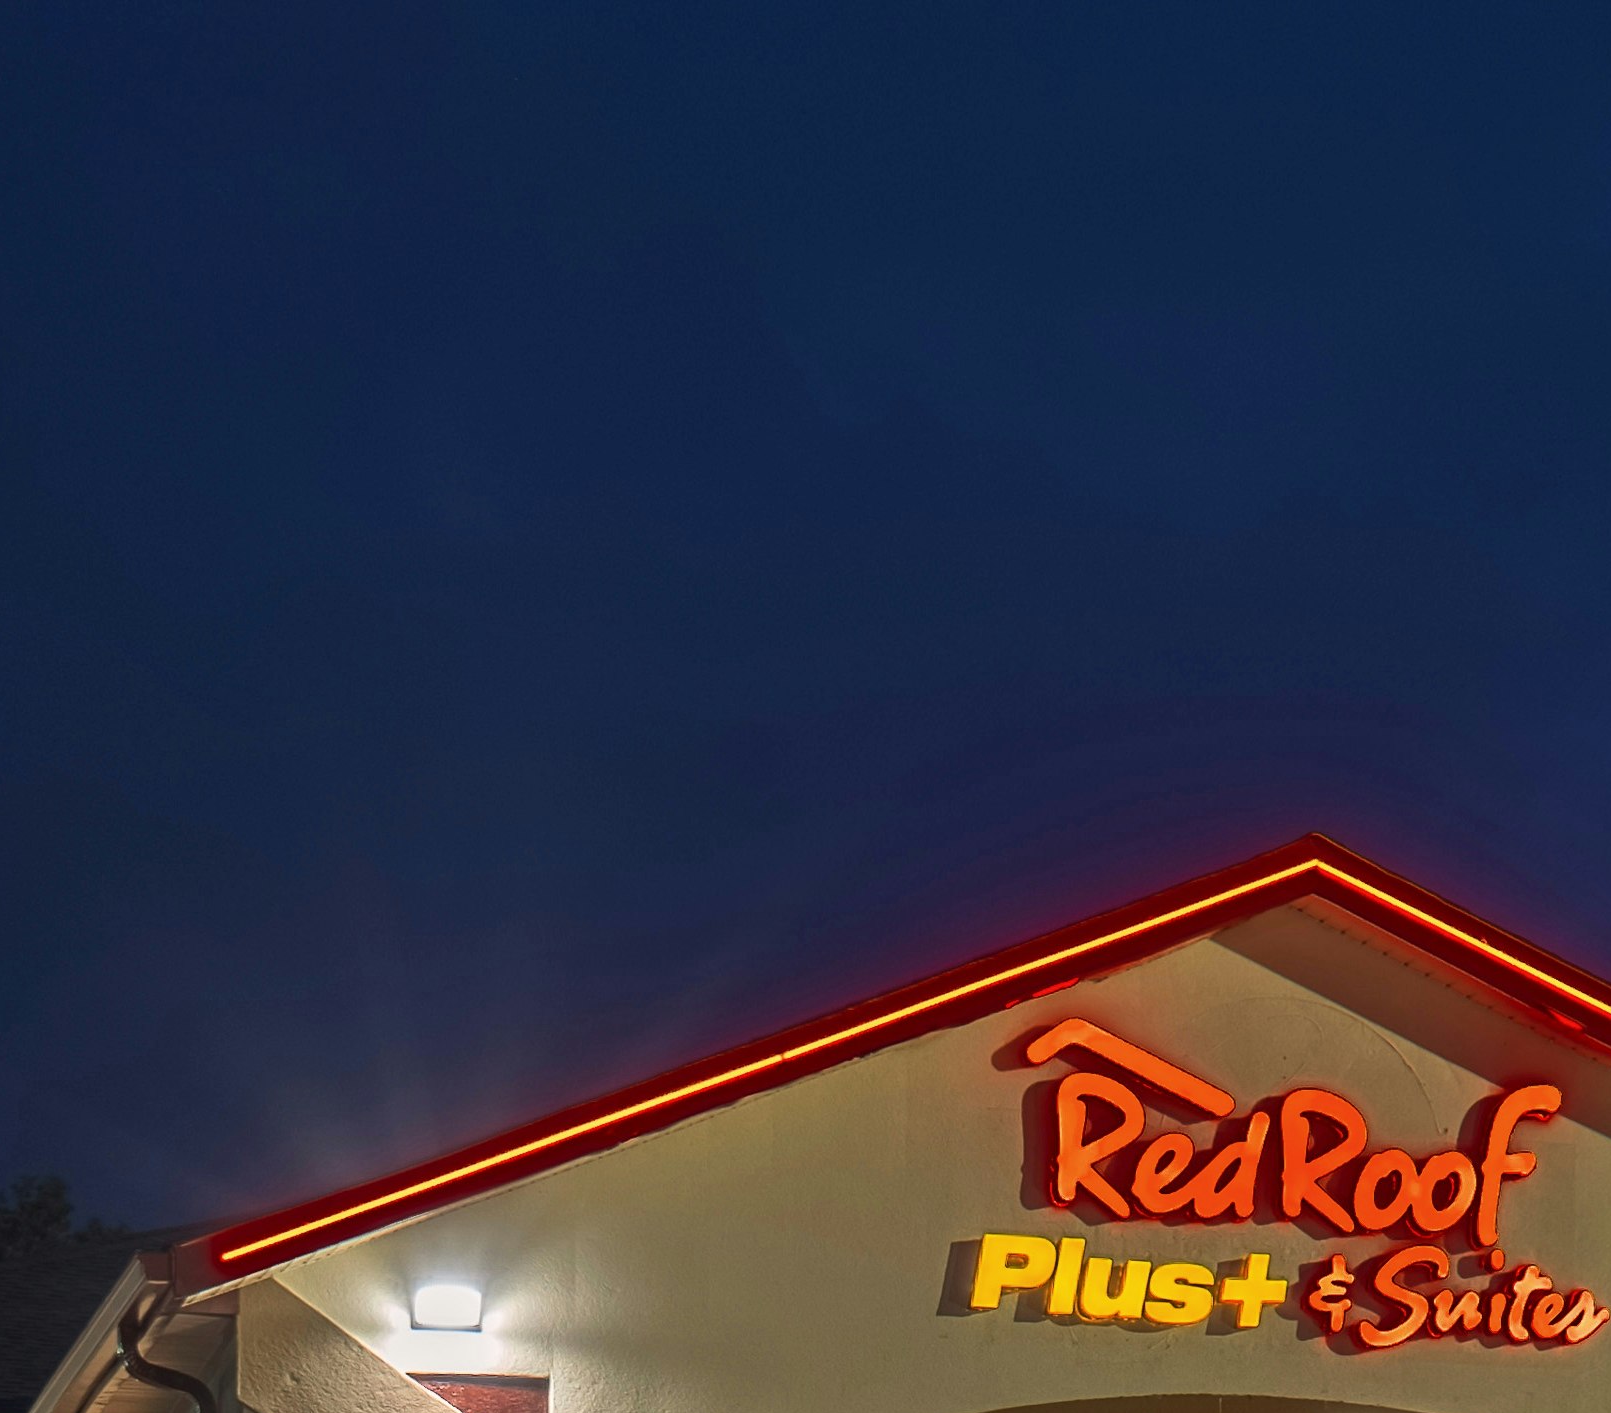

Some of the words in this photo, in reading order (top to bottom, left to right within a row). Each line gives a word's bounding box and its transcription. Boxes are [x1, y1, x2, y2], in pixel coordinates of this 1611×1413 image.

[970, 1233, 1288, 1328] Plus+
[1307, 1253, 1355, 1333] &
[1359, 1245, 1611, 1348] Suites
